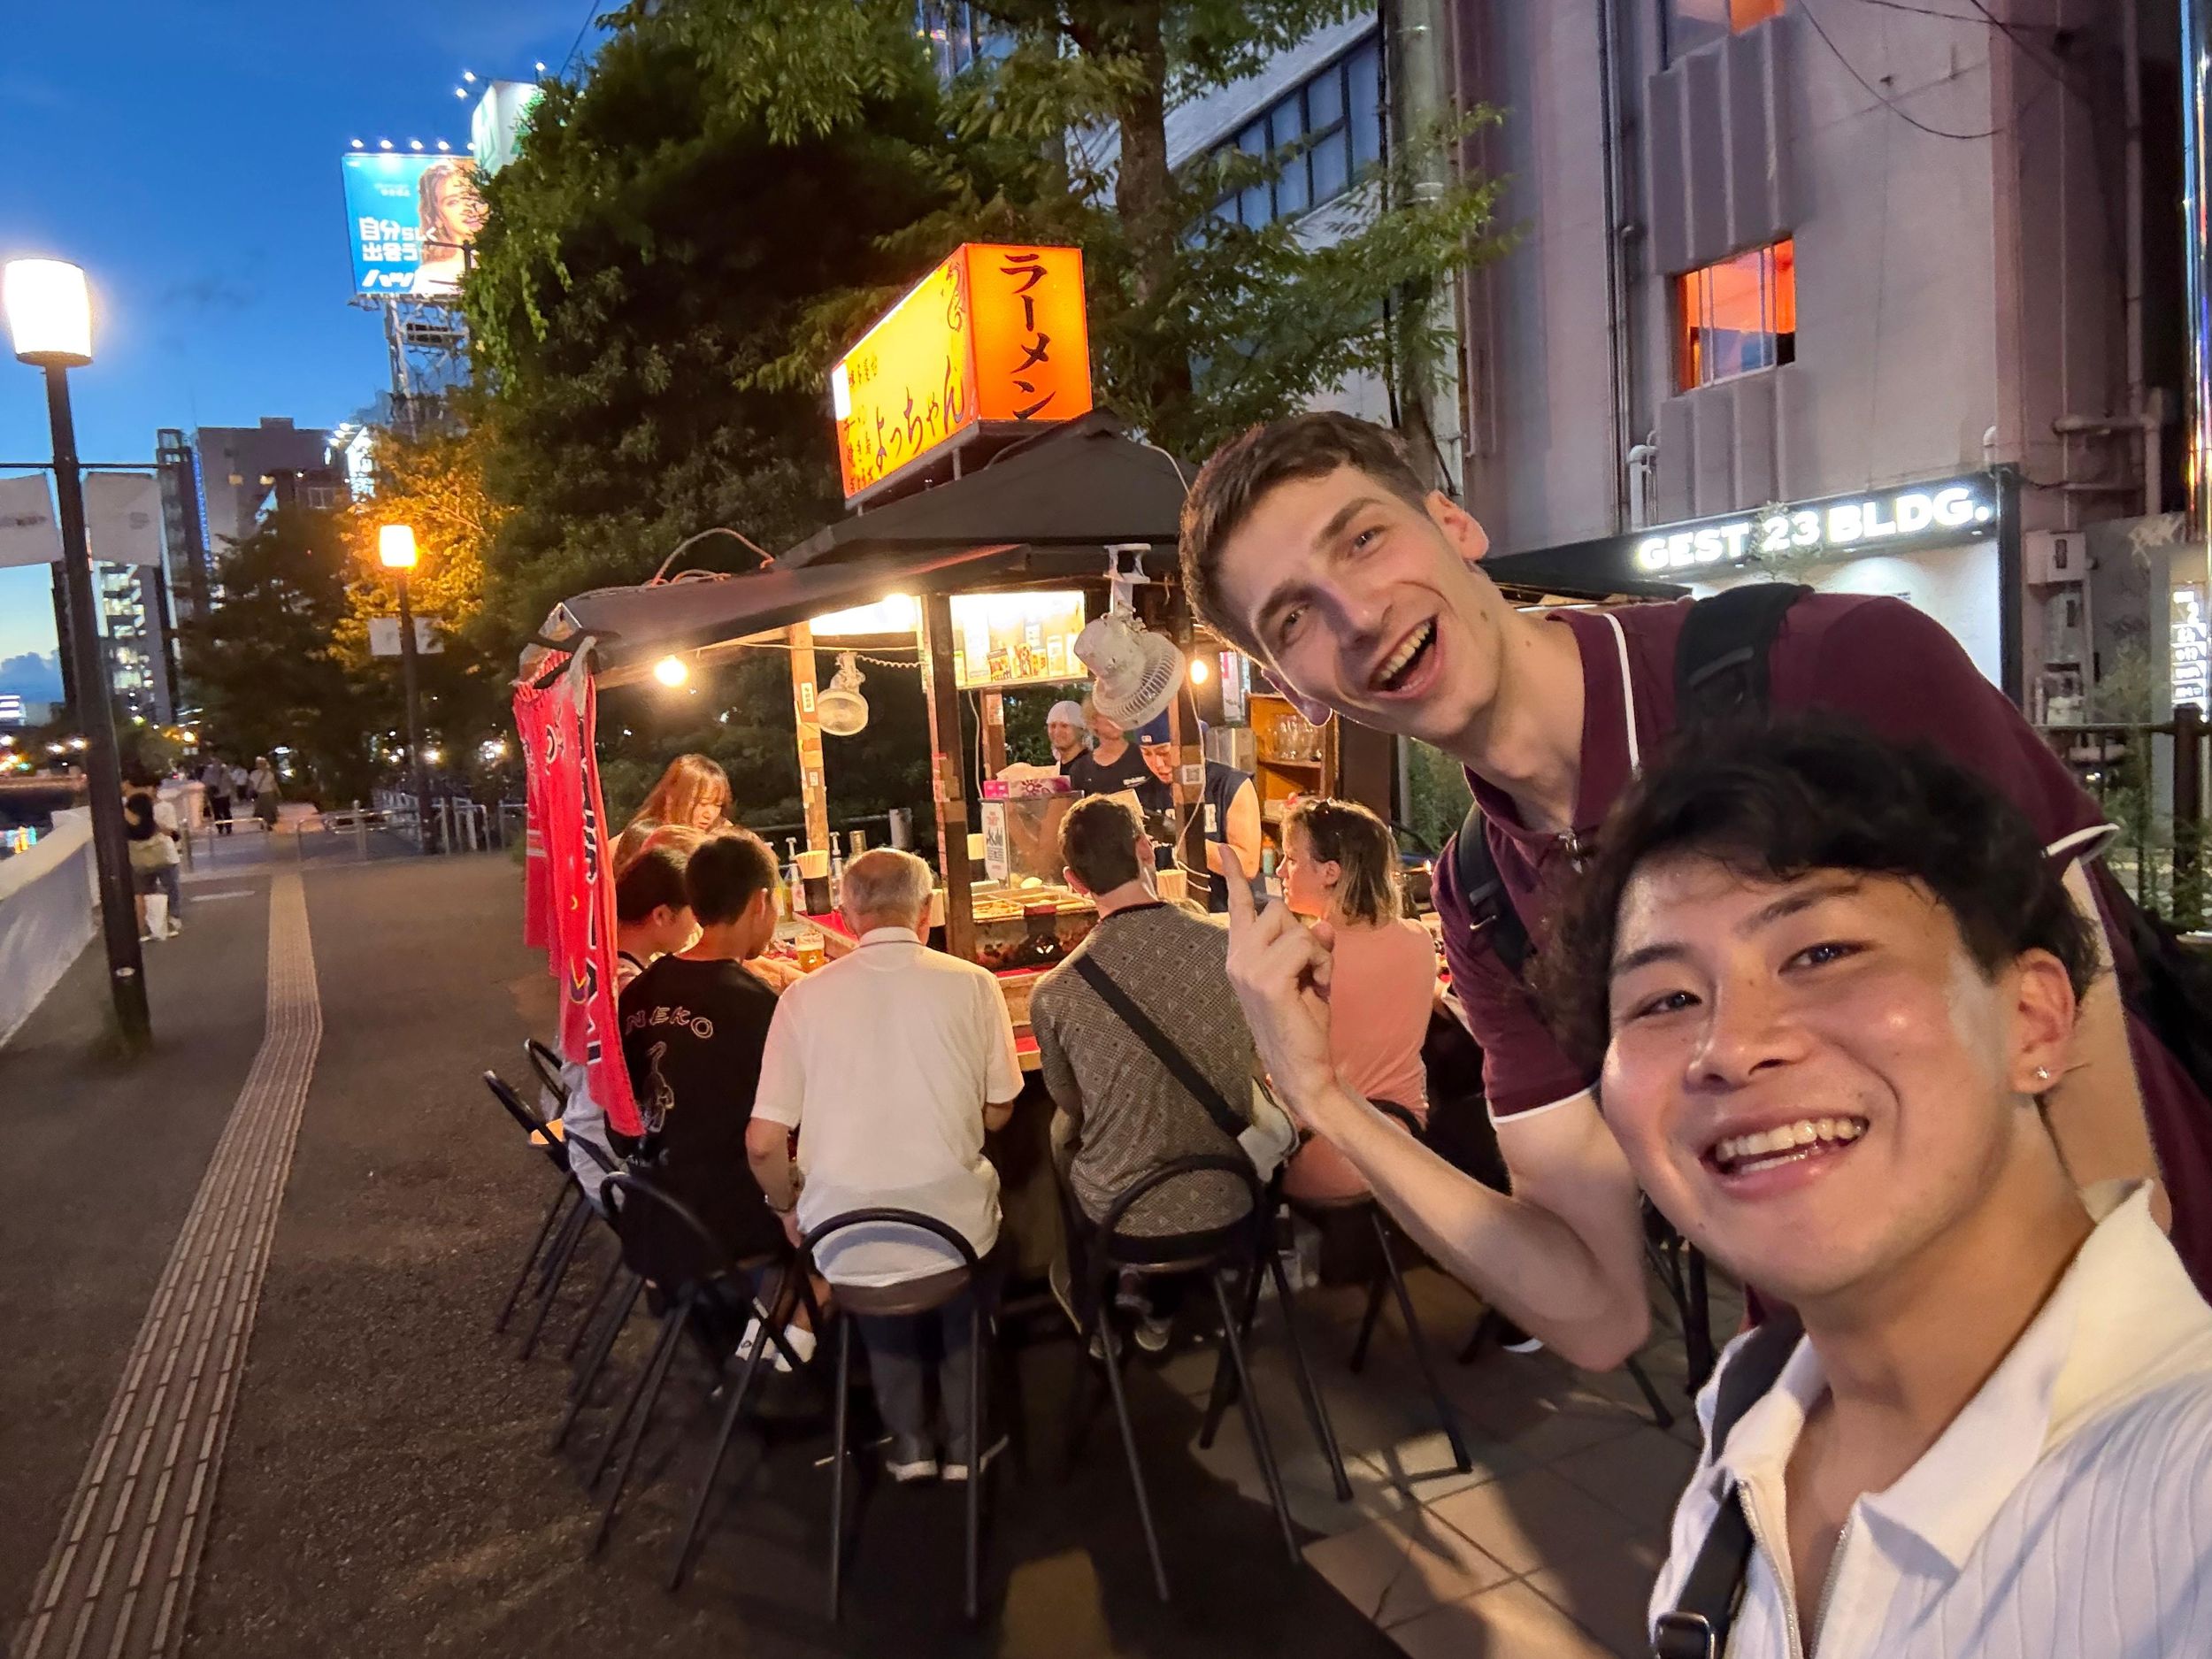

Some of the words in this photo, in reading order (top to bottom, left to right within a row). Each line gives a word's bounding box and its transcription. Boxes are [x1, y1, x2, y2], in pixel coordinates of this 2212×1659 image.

[362, 242, 419, 262] 出会う
[999, 253, 1056, 420] ラーメン
[875, 355, 964, 474] よっちゃん
[1639, 524, 1748, 569] GEST
[1761, 511, 1821, 553] 23
[1828, 488, 1990, 543] BLDG.
[625, 1006, 713, 1039] NEKO
